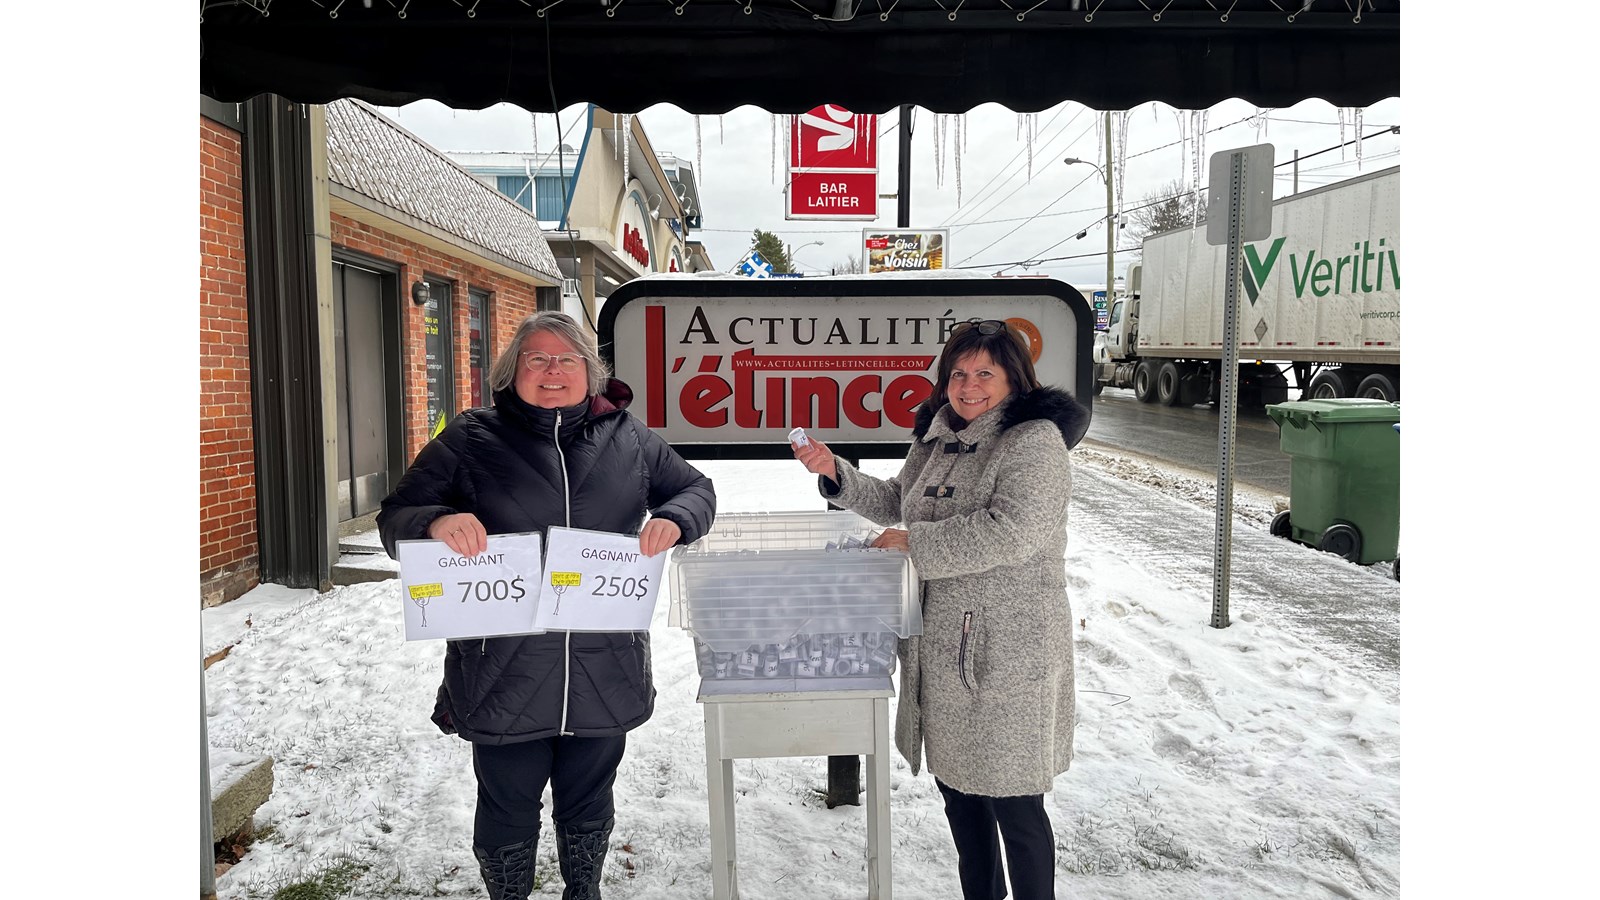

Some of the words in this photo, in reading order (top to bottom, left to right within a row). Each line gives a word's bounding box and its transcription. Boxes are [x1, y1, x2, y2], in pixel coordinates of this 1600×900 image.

[820, 183, 847, 194] BAR
[808, 196, 859, 207] LAITIER
[894, 238, 918, 250] Chez
[884, 251, 928, 268] Voisin
[645, 306, 936, 429] l'étince
[438, 553, 505, 568] GAGNANT
[581, 548, 640, 563] GAGNANT
[457, 575, 526, 603] 700$
[591, 575, 650, 601] 250$
